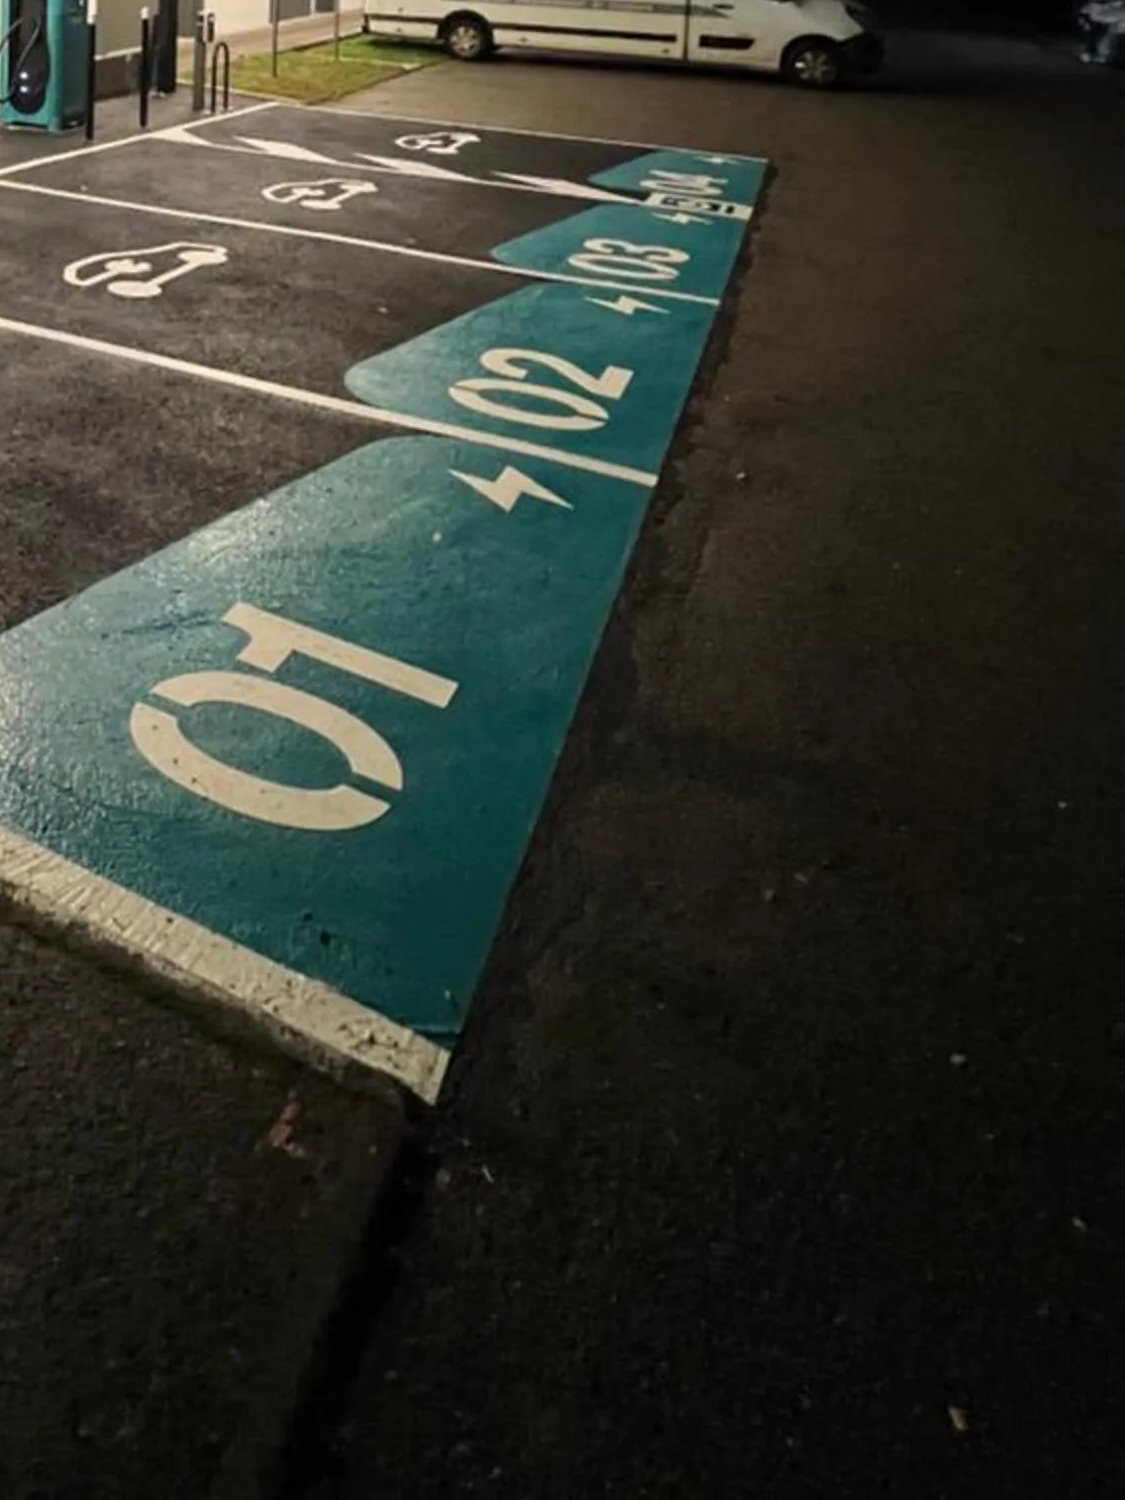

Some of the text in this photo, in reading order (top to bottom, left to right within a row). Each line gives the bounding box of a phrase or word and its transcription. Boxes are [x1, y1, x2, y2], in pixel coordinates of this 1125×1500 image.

[568, 237, 690, 281] 03
[448, 347, 634, 431] 02
[129, 601, 458, 832] 01
